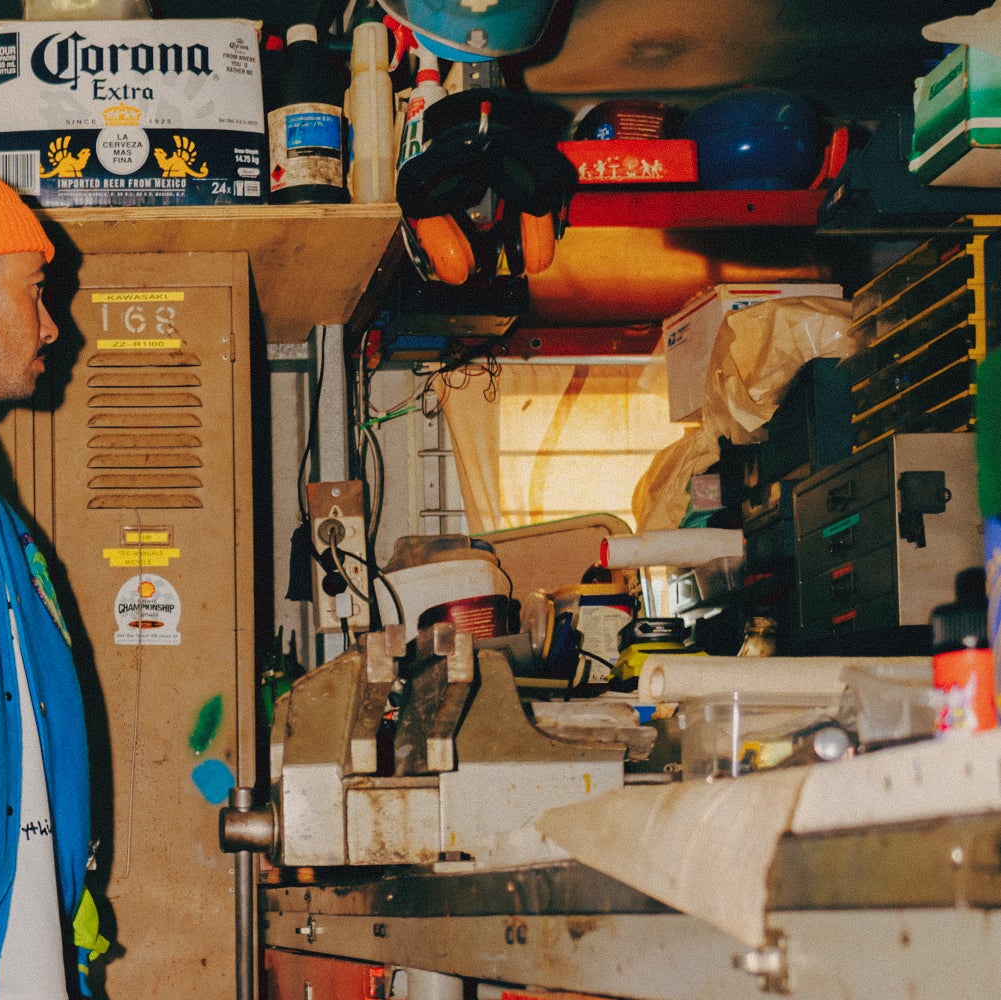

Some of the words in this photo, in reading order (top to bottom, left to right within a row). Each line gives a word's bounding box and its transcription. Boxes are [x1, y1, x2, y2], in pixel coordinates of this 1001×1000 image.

[30, 30, 214, 91] Corona
[91, 78, 154, 101] Extra
[102, 141, 143, 149] CERVEZA
[112, 156, 133, 164] FINA
[58, 178, 101, 189] IMPORTED
[103, 178, 126, 189] BEER
[128, 178, 151, 188] FROM
[154, 178, 187, 188] MEXICO
[101, 303, 176, 335] 168
[118, 603, 175, 614] CHAMPIONSHIP
